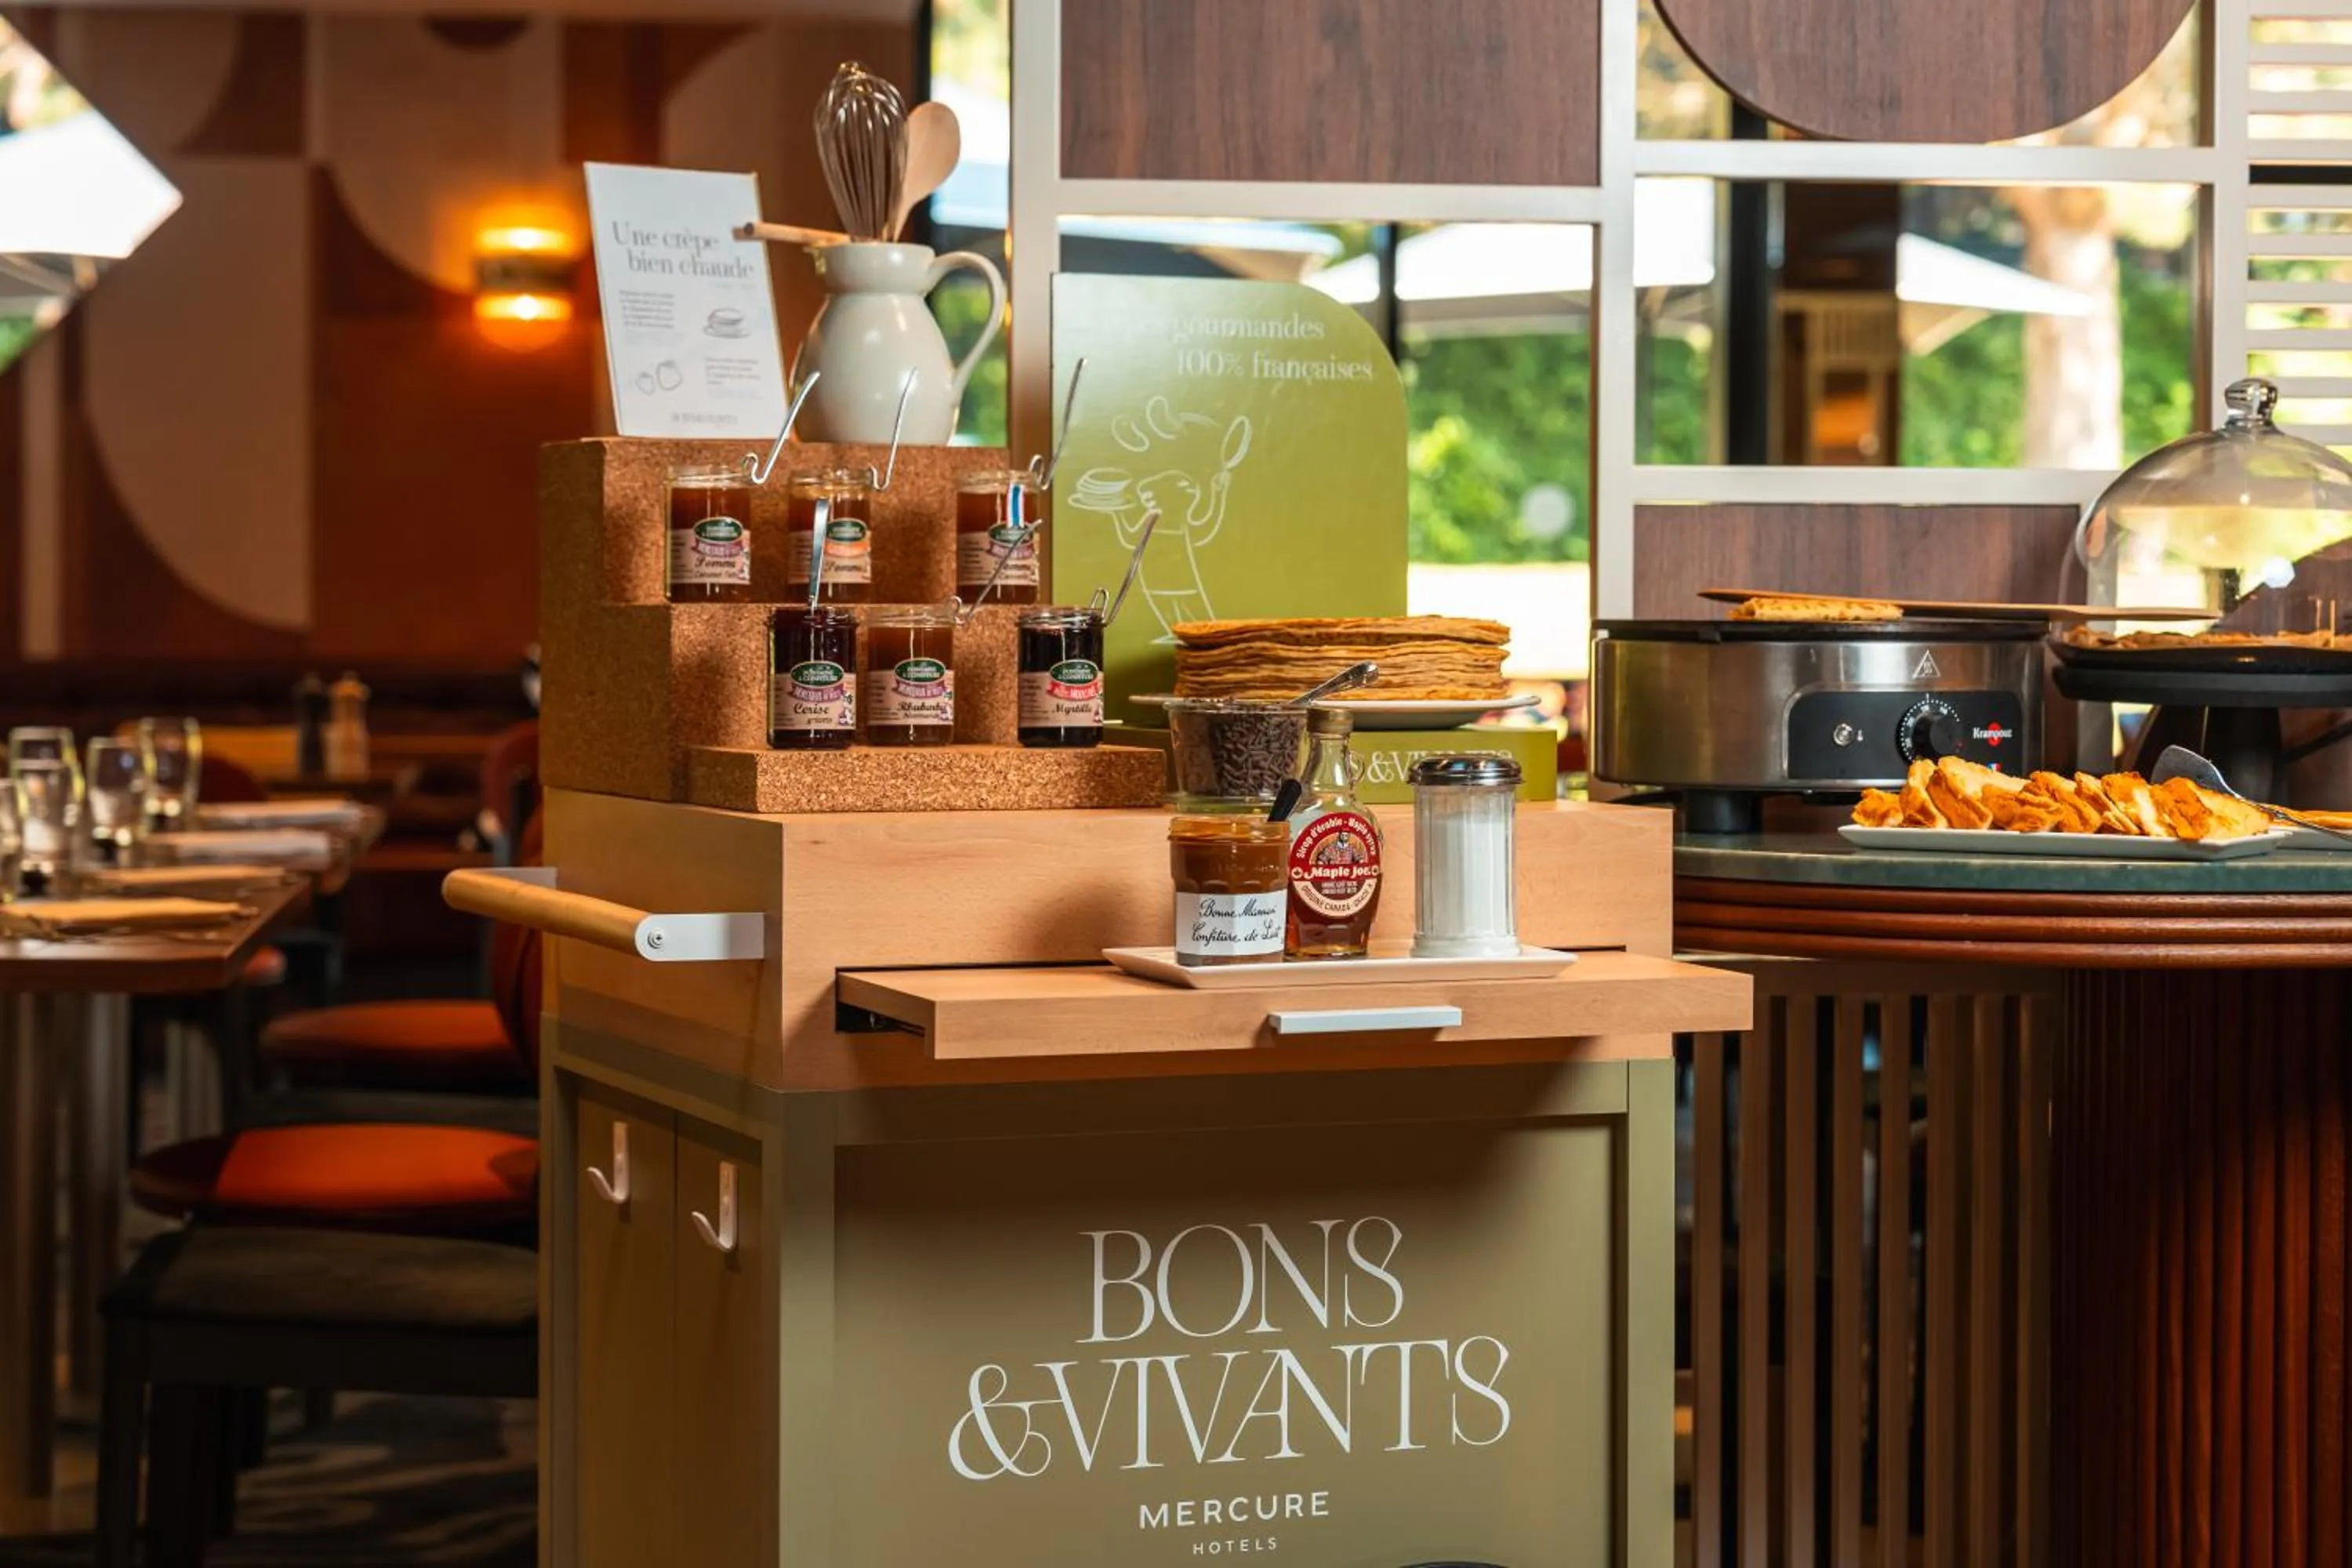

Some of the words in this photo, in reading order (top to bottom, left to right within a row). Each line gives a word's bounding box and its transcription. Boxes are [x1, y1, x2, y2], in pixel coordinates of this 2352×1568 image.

[612, 220, 658, 247] Une
[627, 249, 673, 274] bien
[678, 254, 753, 278] chaude
[1172, 313, 1325, 343] gourmandes
[1177, 350, 1245, 377] 100%
[1253, 350, 1374, 384] françaises
[793, 702, 829, 714] Cerise
[1304, 866, 1350, 879] Maple
[1199, 898, 1237, 917] Bonne
[1192, 921, 1240, 947] Confiture
[1244, 928, 1258, 942] de
[1076, 1215, 1405, 1344] BONS
[1138, 1491, 1330, 1530] MERCURE
[1192, 1537, 1279, 1555] HOTELS
